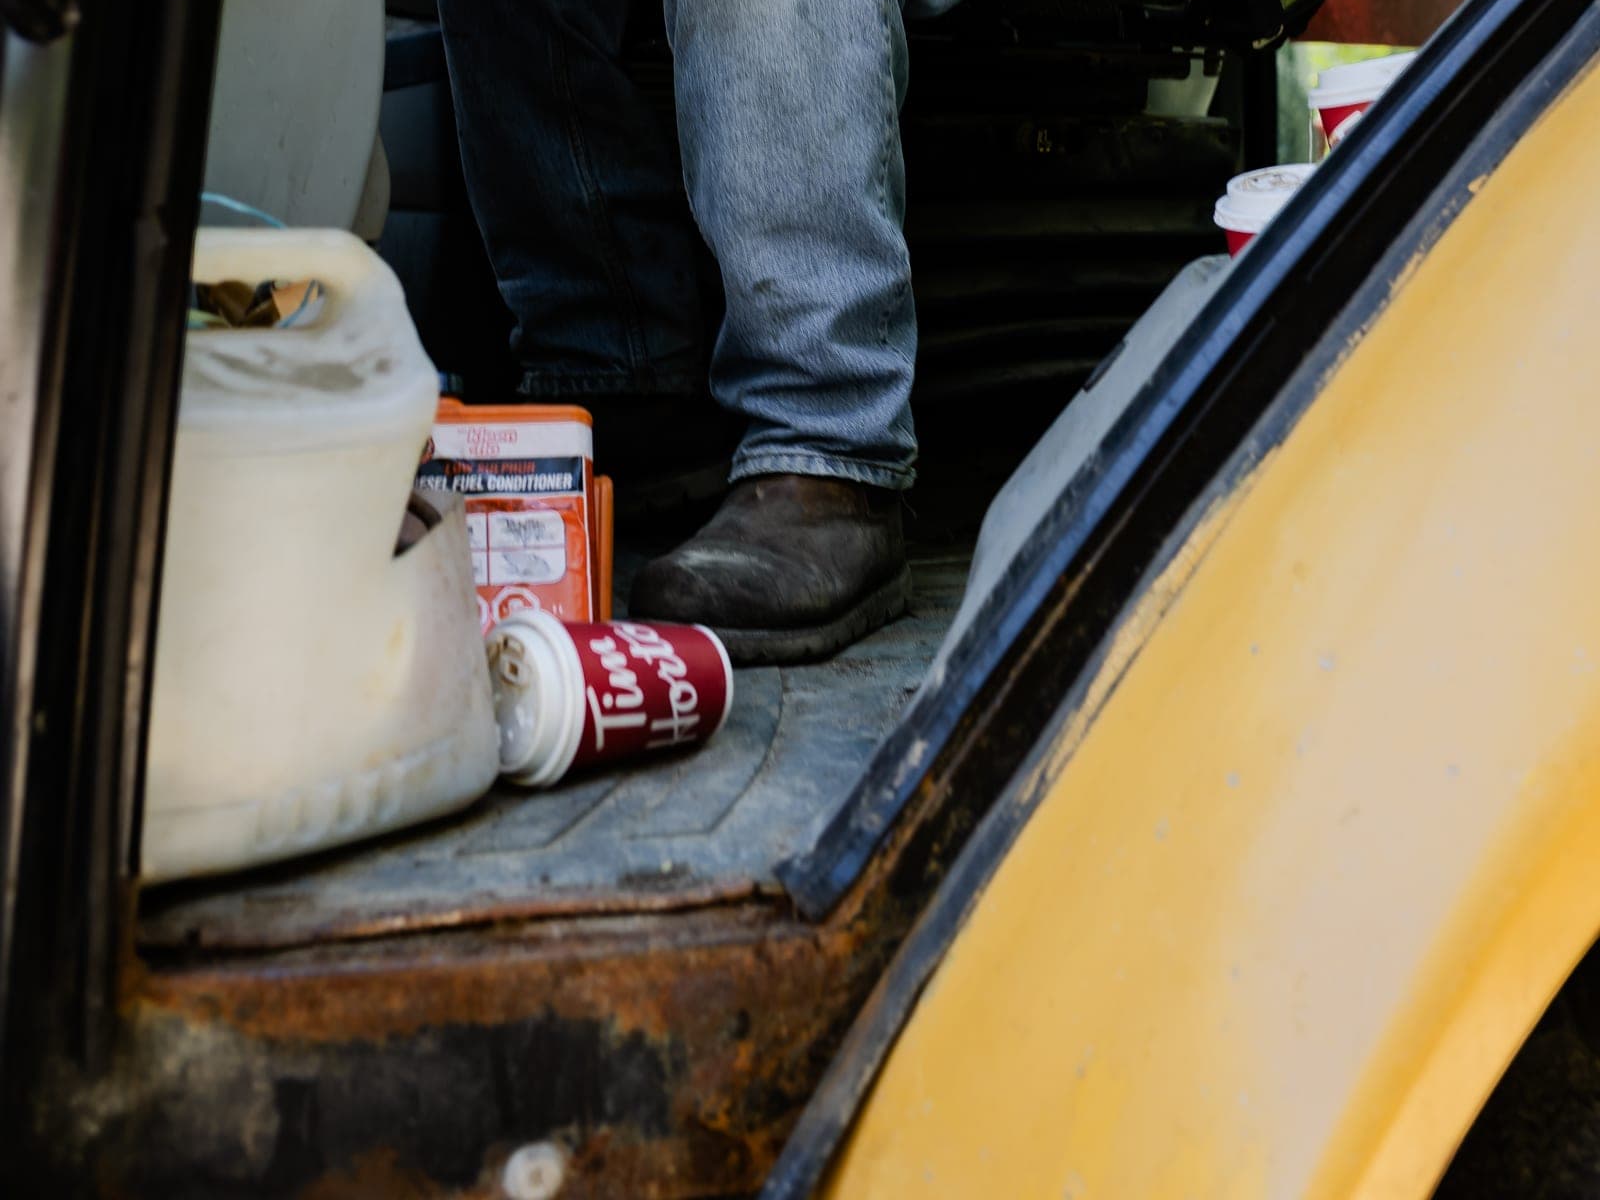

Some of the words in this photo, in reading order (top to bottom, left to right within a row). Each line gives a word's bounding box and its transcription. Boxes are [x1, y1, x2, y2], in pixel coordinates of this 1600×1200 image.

[452, 473, 485, 492] FUEL
[486, 472, 574, 491] CONDITIONER
[586, 635, 648, 751] Tim
